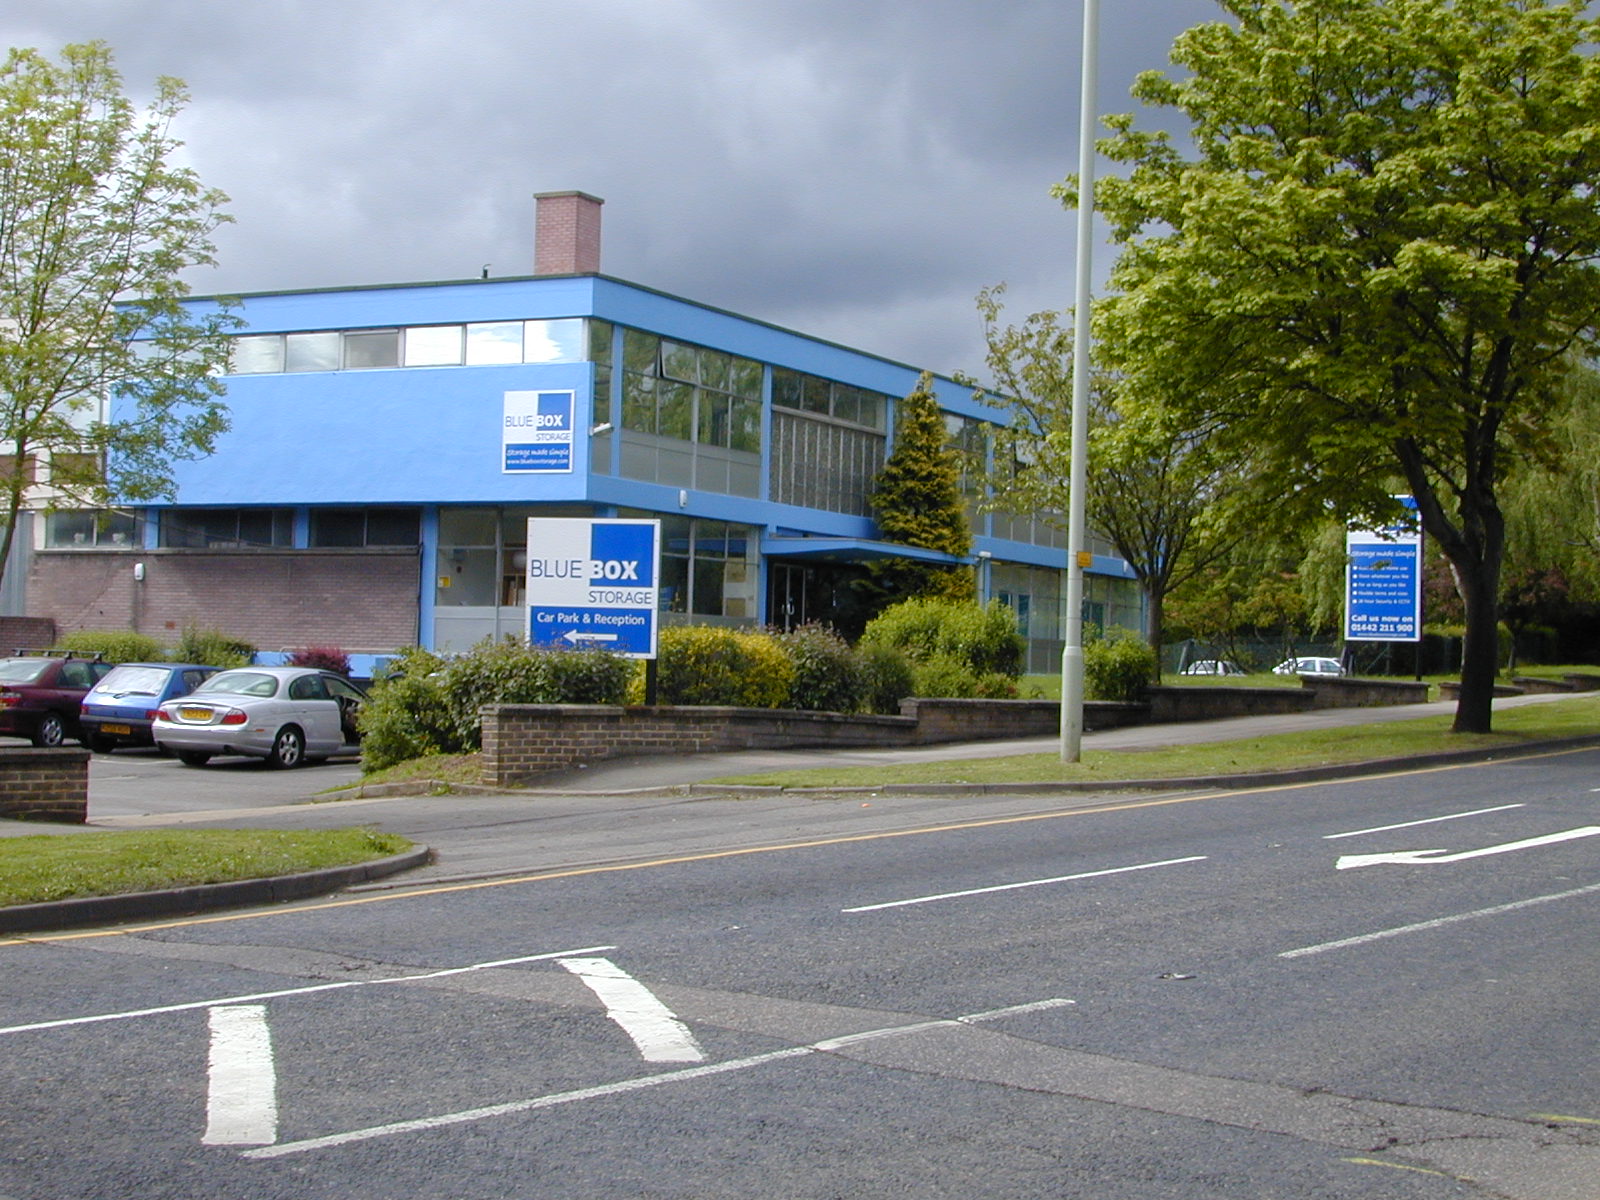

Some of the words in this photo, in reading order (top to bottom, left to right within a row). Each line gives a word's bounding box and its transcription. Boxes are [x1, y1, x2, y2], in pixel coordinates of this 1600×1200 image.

[505, 416, 533, 427] BLUE
[536, 415, 563, 427] BOX
[536, 433, 571, 441] STORAGE
[549, 448, 569, 458] simple
[1395, 550, 1416, 559] simple
[531, 559, 582, 578] BLUE
[589, 560, 638, 580] BOX
[588, 591, 652, 605] STORAGE
[537, 612, 554, 623] Car
[557, 613, 579, 624] Park
[583, 613, 591, 624] &
[594, 614, 645, 627] Reception
[1351, 614, 1367, 622] Call
[1379, 624, 1395, 632] 211
[1396, 624, 1413, 632] 900
